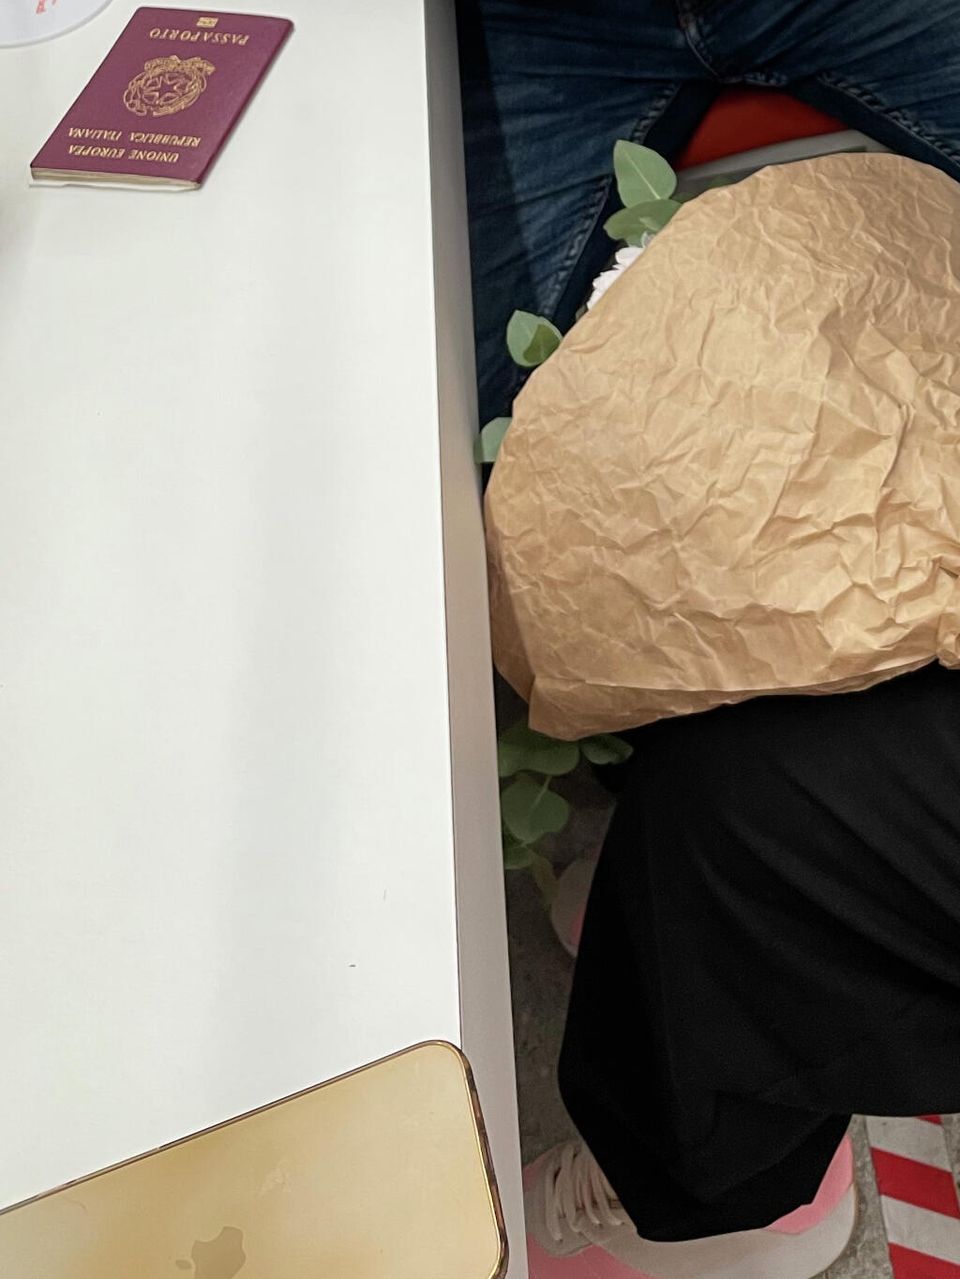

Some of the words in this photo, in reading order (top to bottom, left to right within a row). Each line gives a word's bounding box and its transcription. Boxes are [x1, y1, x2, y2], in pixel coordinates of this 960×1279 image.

[149, 28, 249, 46] PASSAPORTO
[68, 127, 122, 141] ITALIANA
[129, 132, 201, 148] REPUBBLICA
[68, 144, 125, 159] EUROPEA
[128, 149, 179, 163] UNIONE
